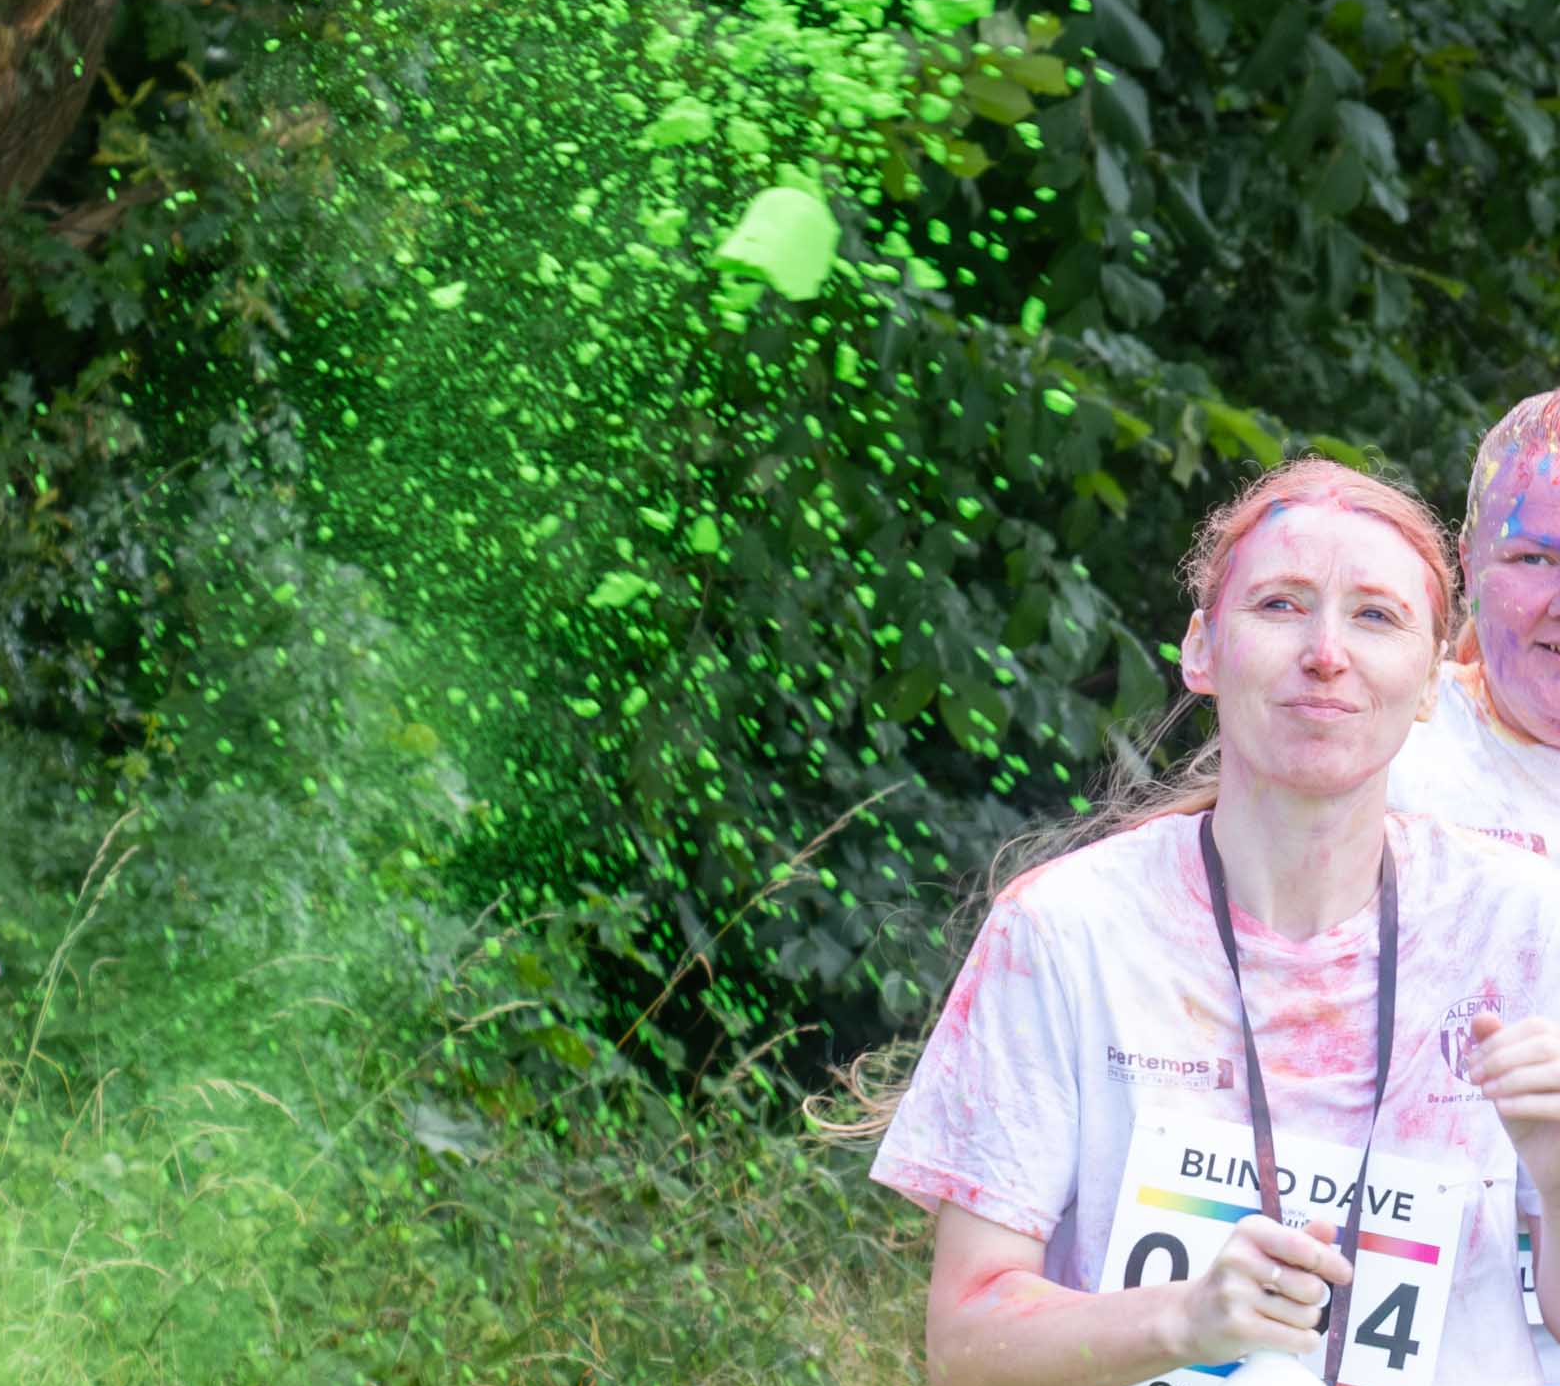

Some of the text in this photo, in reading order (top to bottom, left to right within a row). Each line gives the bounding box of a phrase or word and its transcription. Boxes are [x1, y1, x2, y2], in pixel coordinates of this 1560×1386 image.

[1445, 998, 1502, 1021] ALBION
[1107, 1045, 1210, 1076] Pertemps
[1180, 1148, 1297, 1196] BLIND
[1309, 1174, 1415, 1222] DAVE
